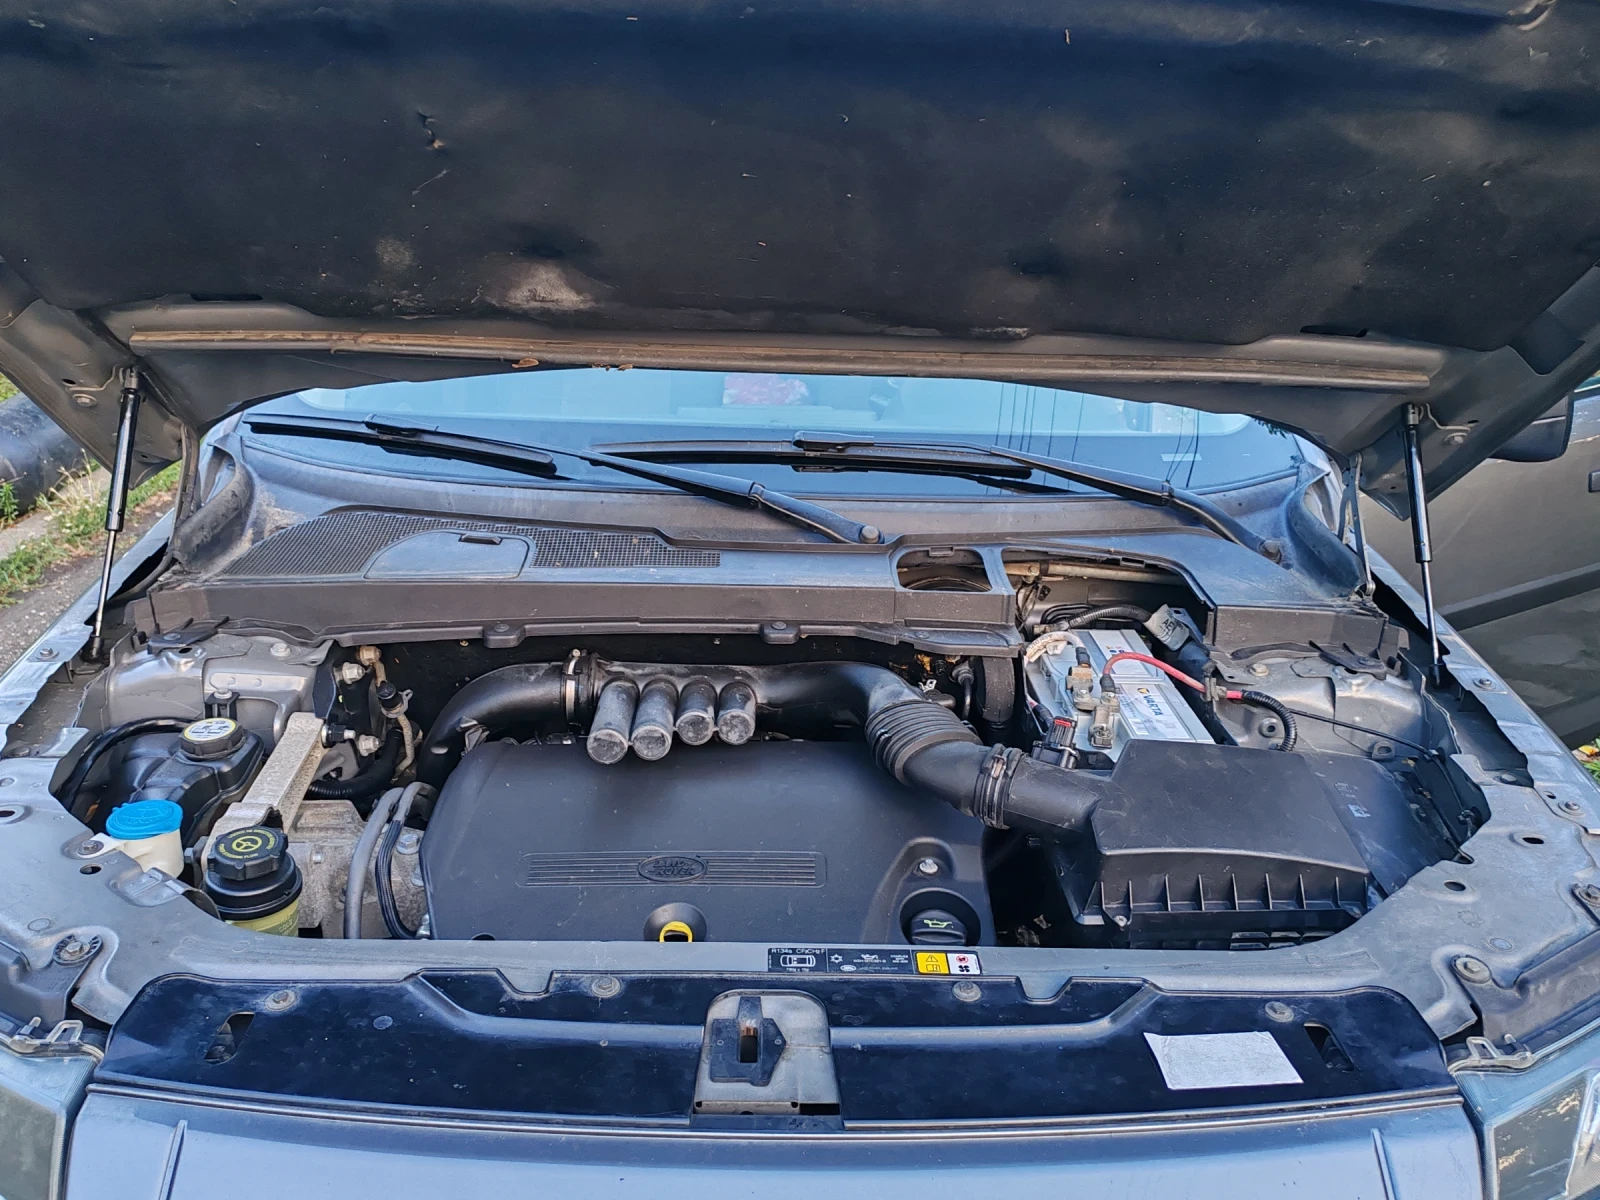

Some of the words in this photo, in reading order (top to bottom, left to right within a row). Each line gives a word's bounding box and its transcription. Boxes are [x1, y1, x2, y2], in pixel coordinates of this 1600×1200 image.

[1143, 694, 1164, 716] VARTA
[653, 859, 686, 868] LAND
[656, 867, 696, 876] ROVER
